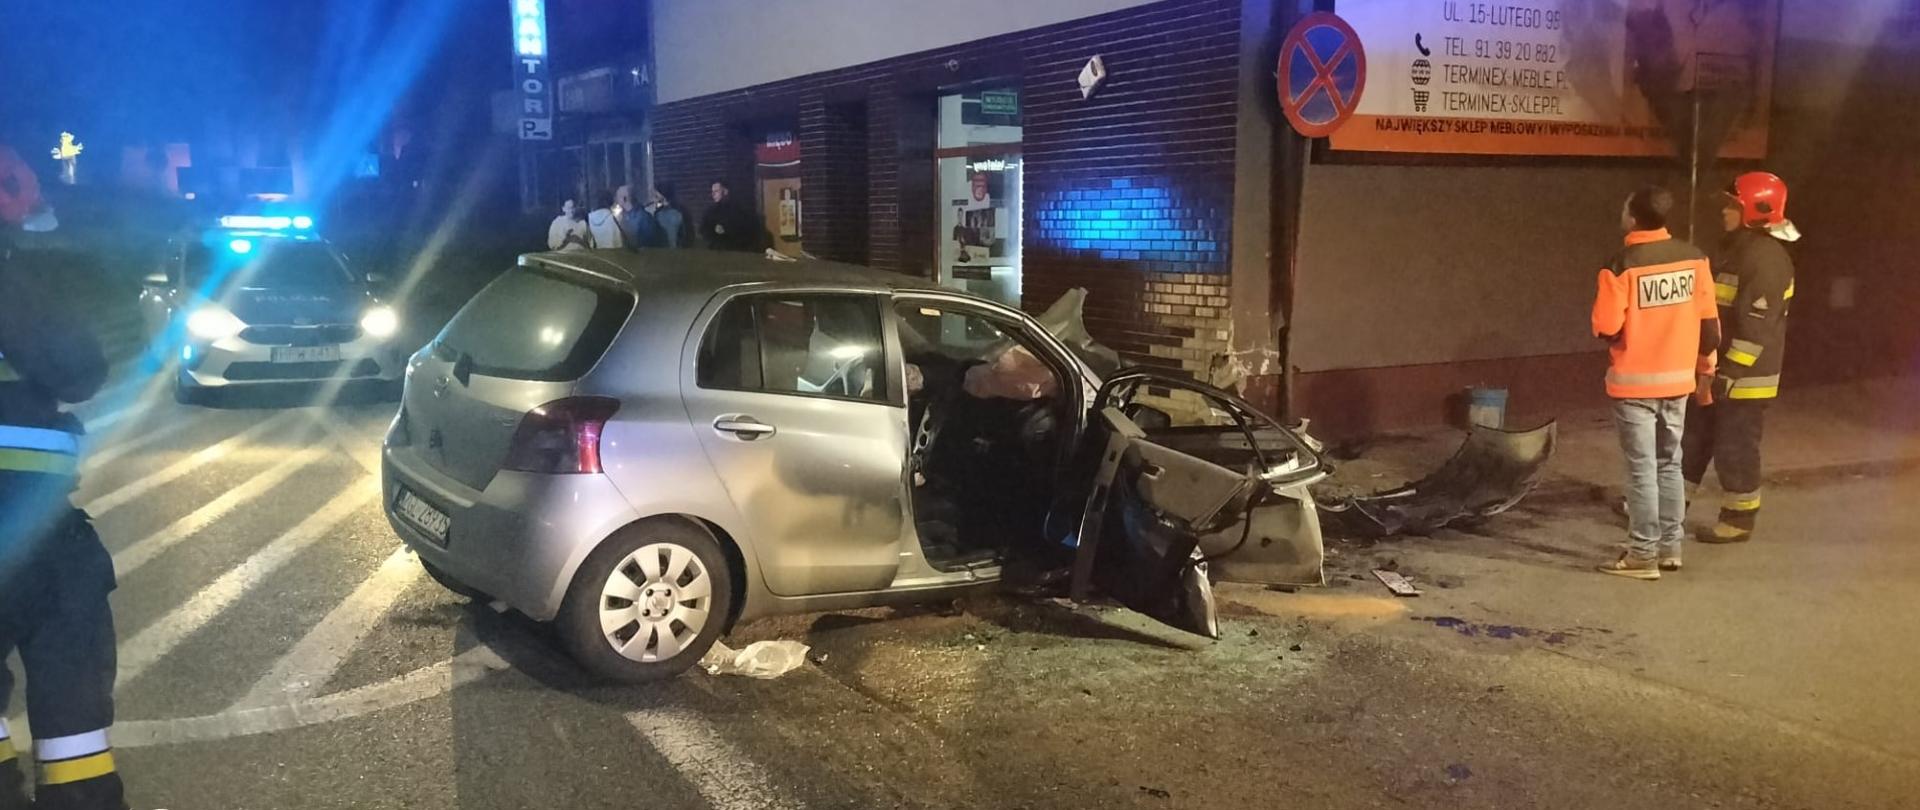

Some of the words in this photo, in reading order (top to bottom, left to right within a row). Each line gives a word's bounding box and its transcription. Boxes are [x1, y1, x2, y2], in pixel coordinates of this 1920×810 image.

[1470, 3, 1542, 29] 15-LUTEGO
[1475, 39, 1491, 59] 91
[1496, 40, 1512, 61] 39
[1515, 42, 1531, 62] 20
[1375, 118, 1451, 135] NAJWIĘKSZY
[1455, 121, 1488, 134] SKLEP
[1490, 121, 1544, 136] MEBLOWY
